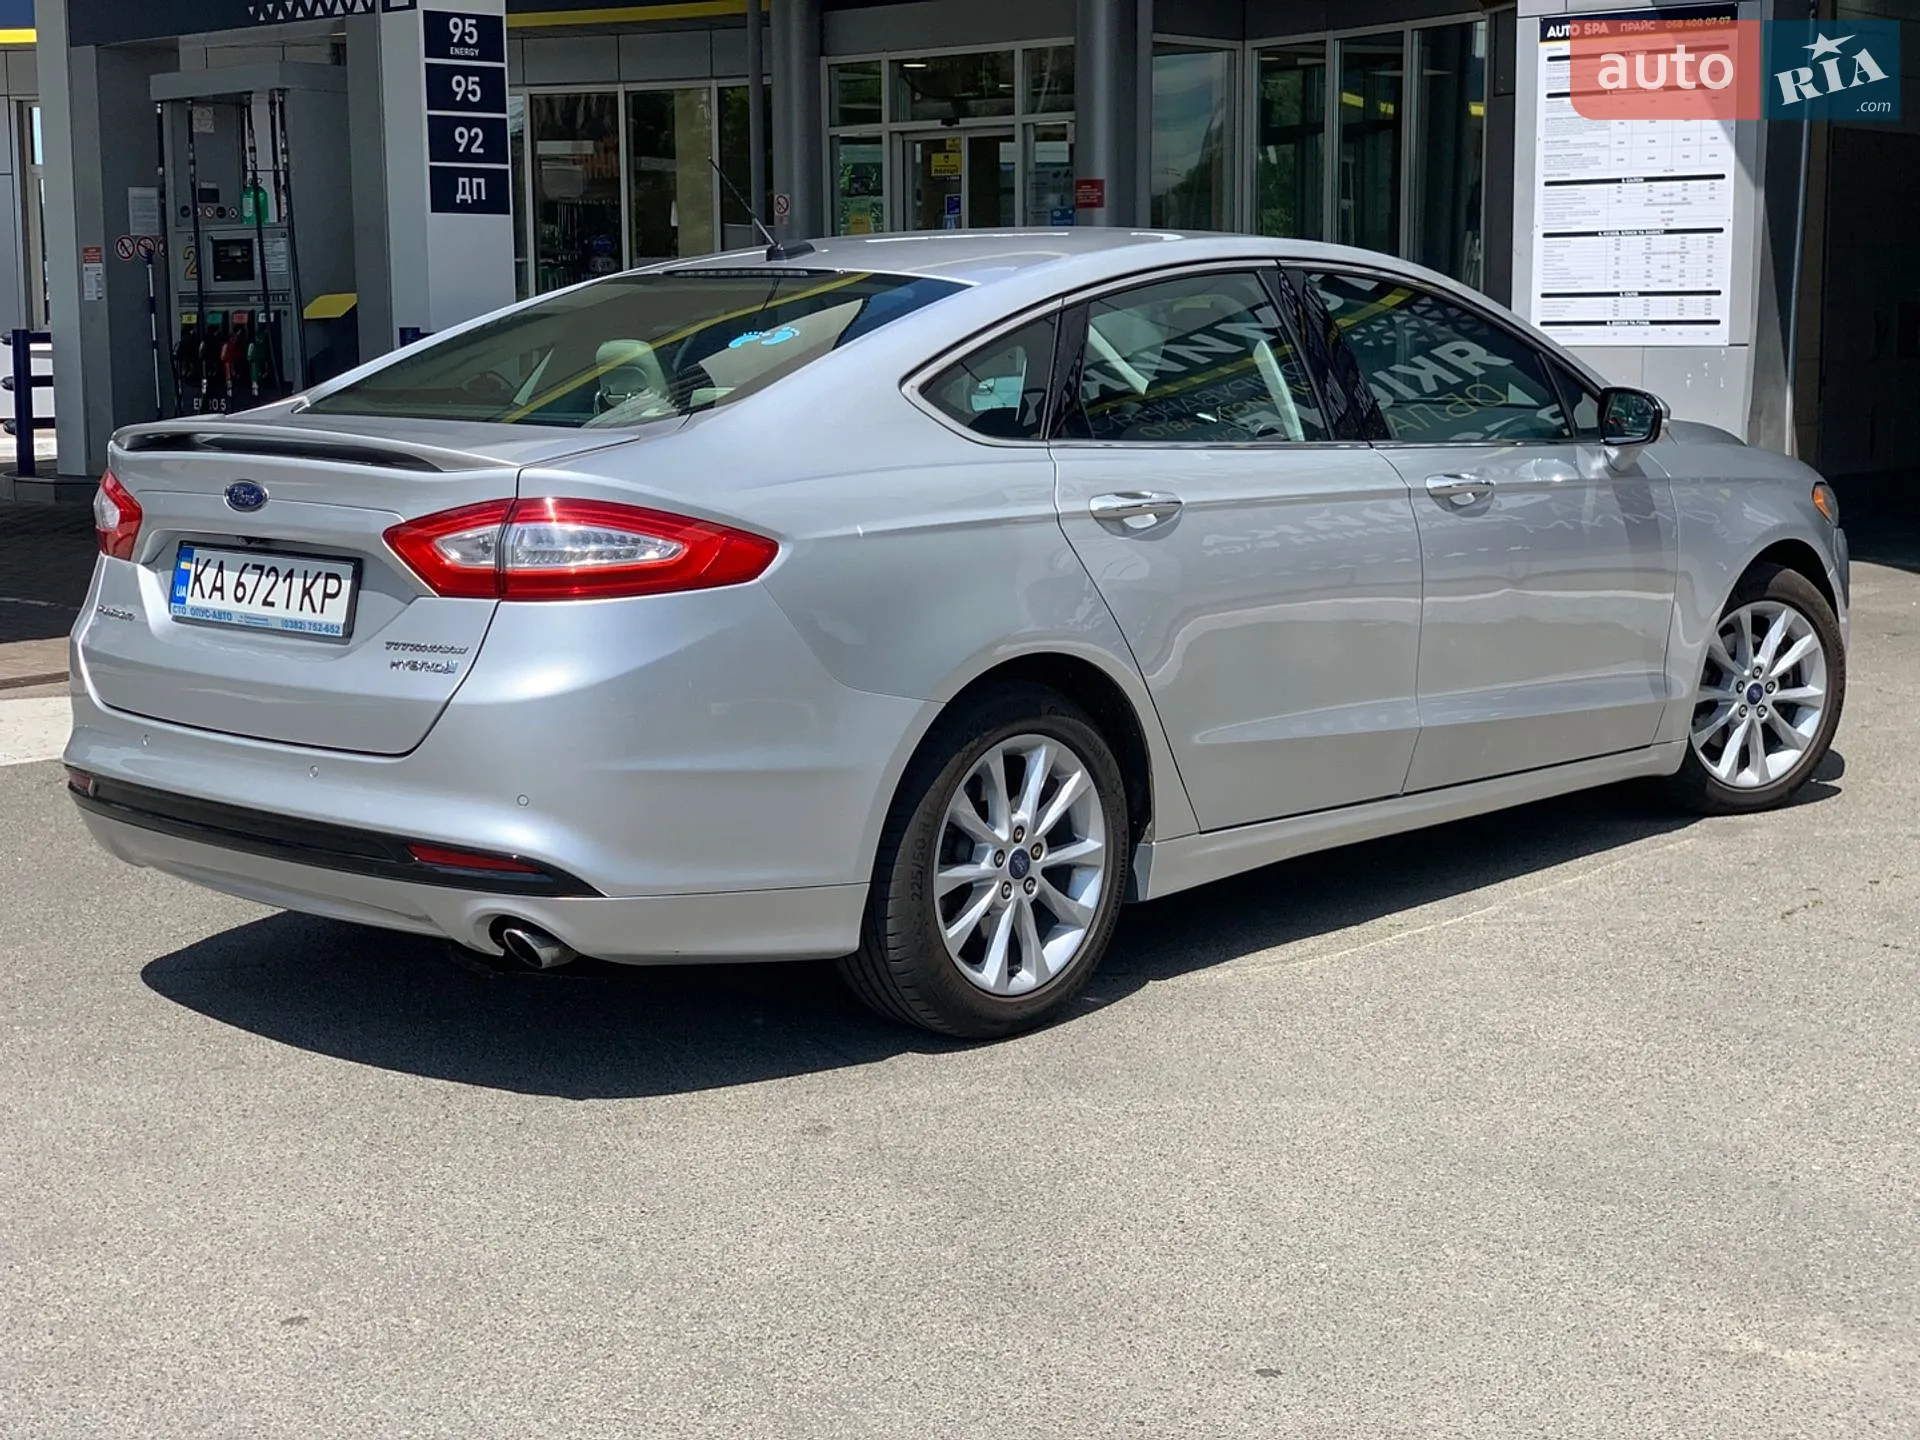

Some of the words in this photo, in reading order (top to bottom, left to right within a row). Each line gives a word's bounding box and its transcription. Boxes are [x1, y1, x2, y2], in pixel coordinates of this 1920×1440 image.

[449, 17, 478, 44] 95
[1546, 24, 1580, 38] AUTO
[1584, 22, 1610, 36] SPA
[1620, 19, 1656, 32] ПРАЙС
[449, 47, 480, 57] ENERGY
[452, 75, 481, 102] 95
[454, 126, 484, 153] 92
[455, 177, 486, 204] ДП
[175, 585, 187, 598] UA
[189, 557, 225, 601] KA
[233, 562, 295, 610] 6721
[298, 568, 343, 615] KP
[172, 605, 187, 615] СТО
